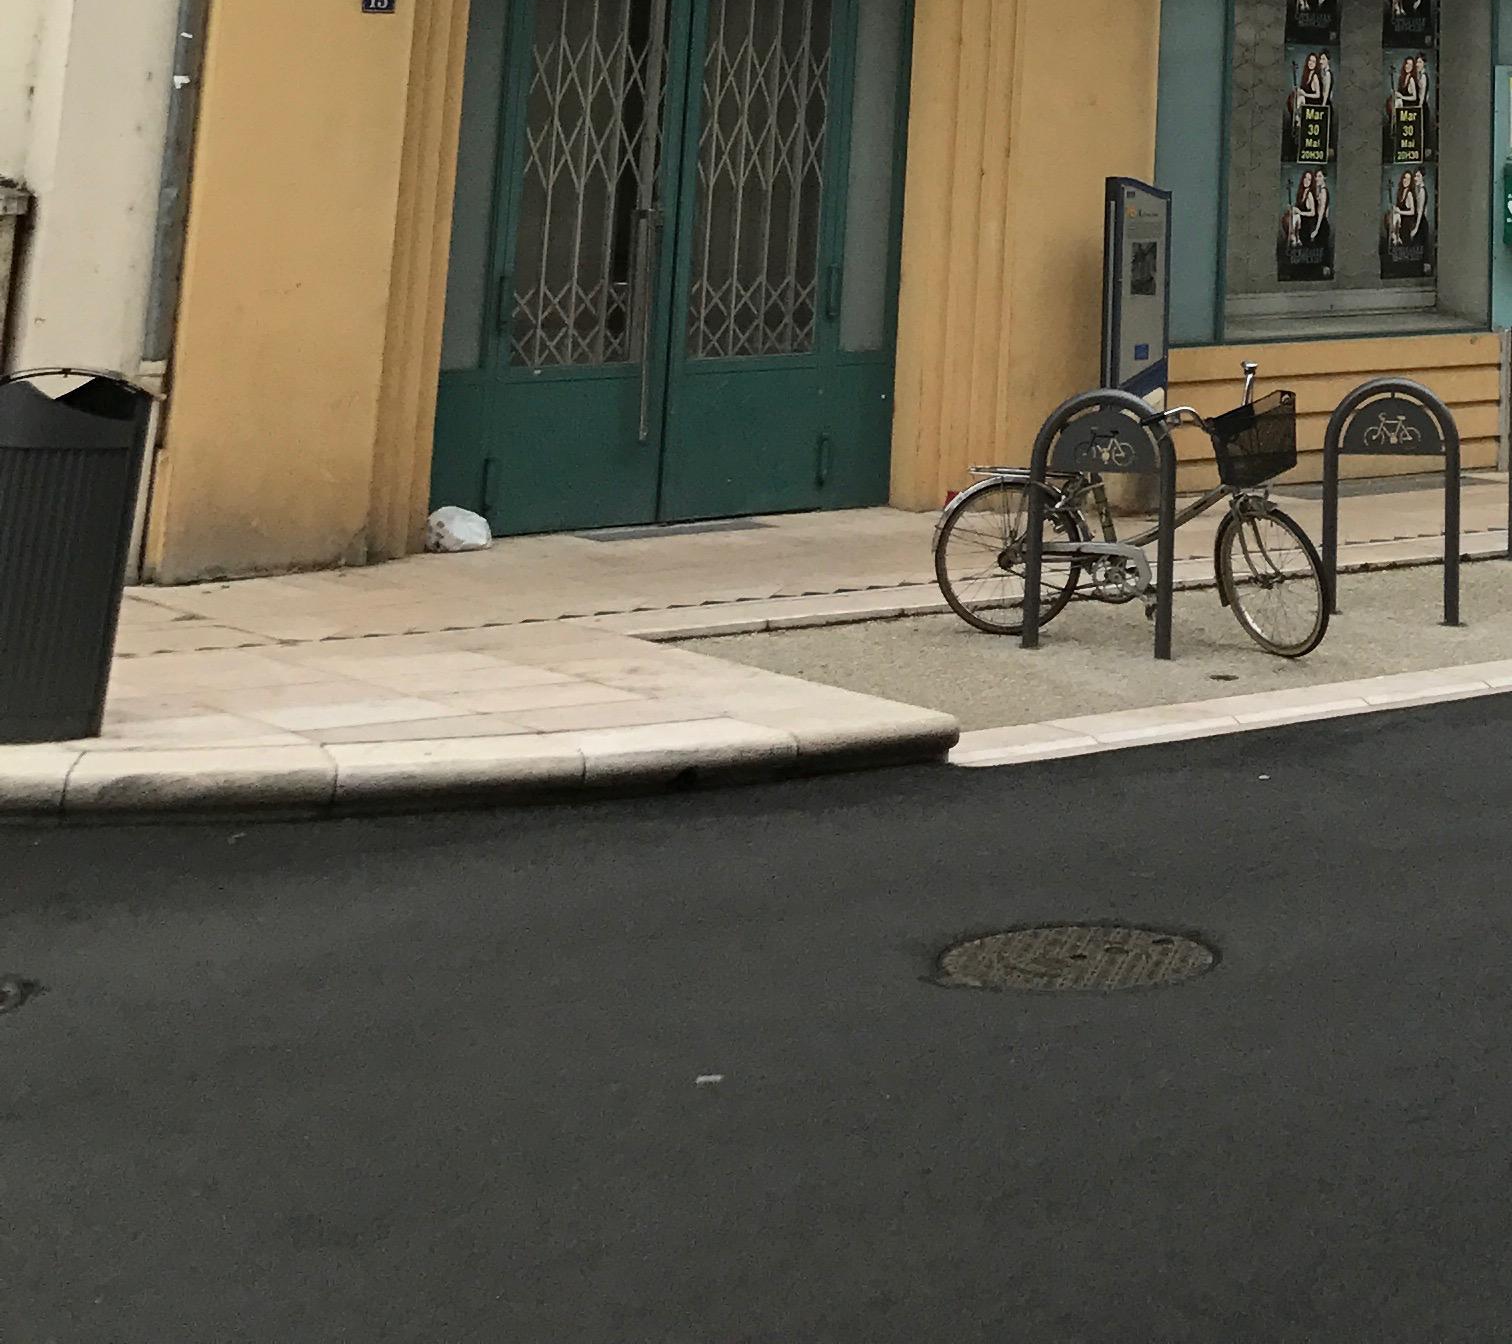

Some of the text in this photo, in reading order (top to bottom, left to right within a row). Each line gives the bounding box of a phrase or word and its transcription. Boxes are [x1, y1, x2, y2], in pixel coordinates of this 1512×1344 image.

[1305, 108, 1325, 121] Mar
[1399, 110, 1417, 122] Mar
[1307, 124, 1320, 136] 30
[1402, 125, 1414, 137] 30
[1305, 138, 1321, 149] Mai
[1400, 139, 1415, 149] Mai
[1300, 150, 1325, 161] 20H30
[1396, 150, 1419, 161] 20H30
